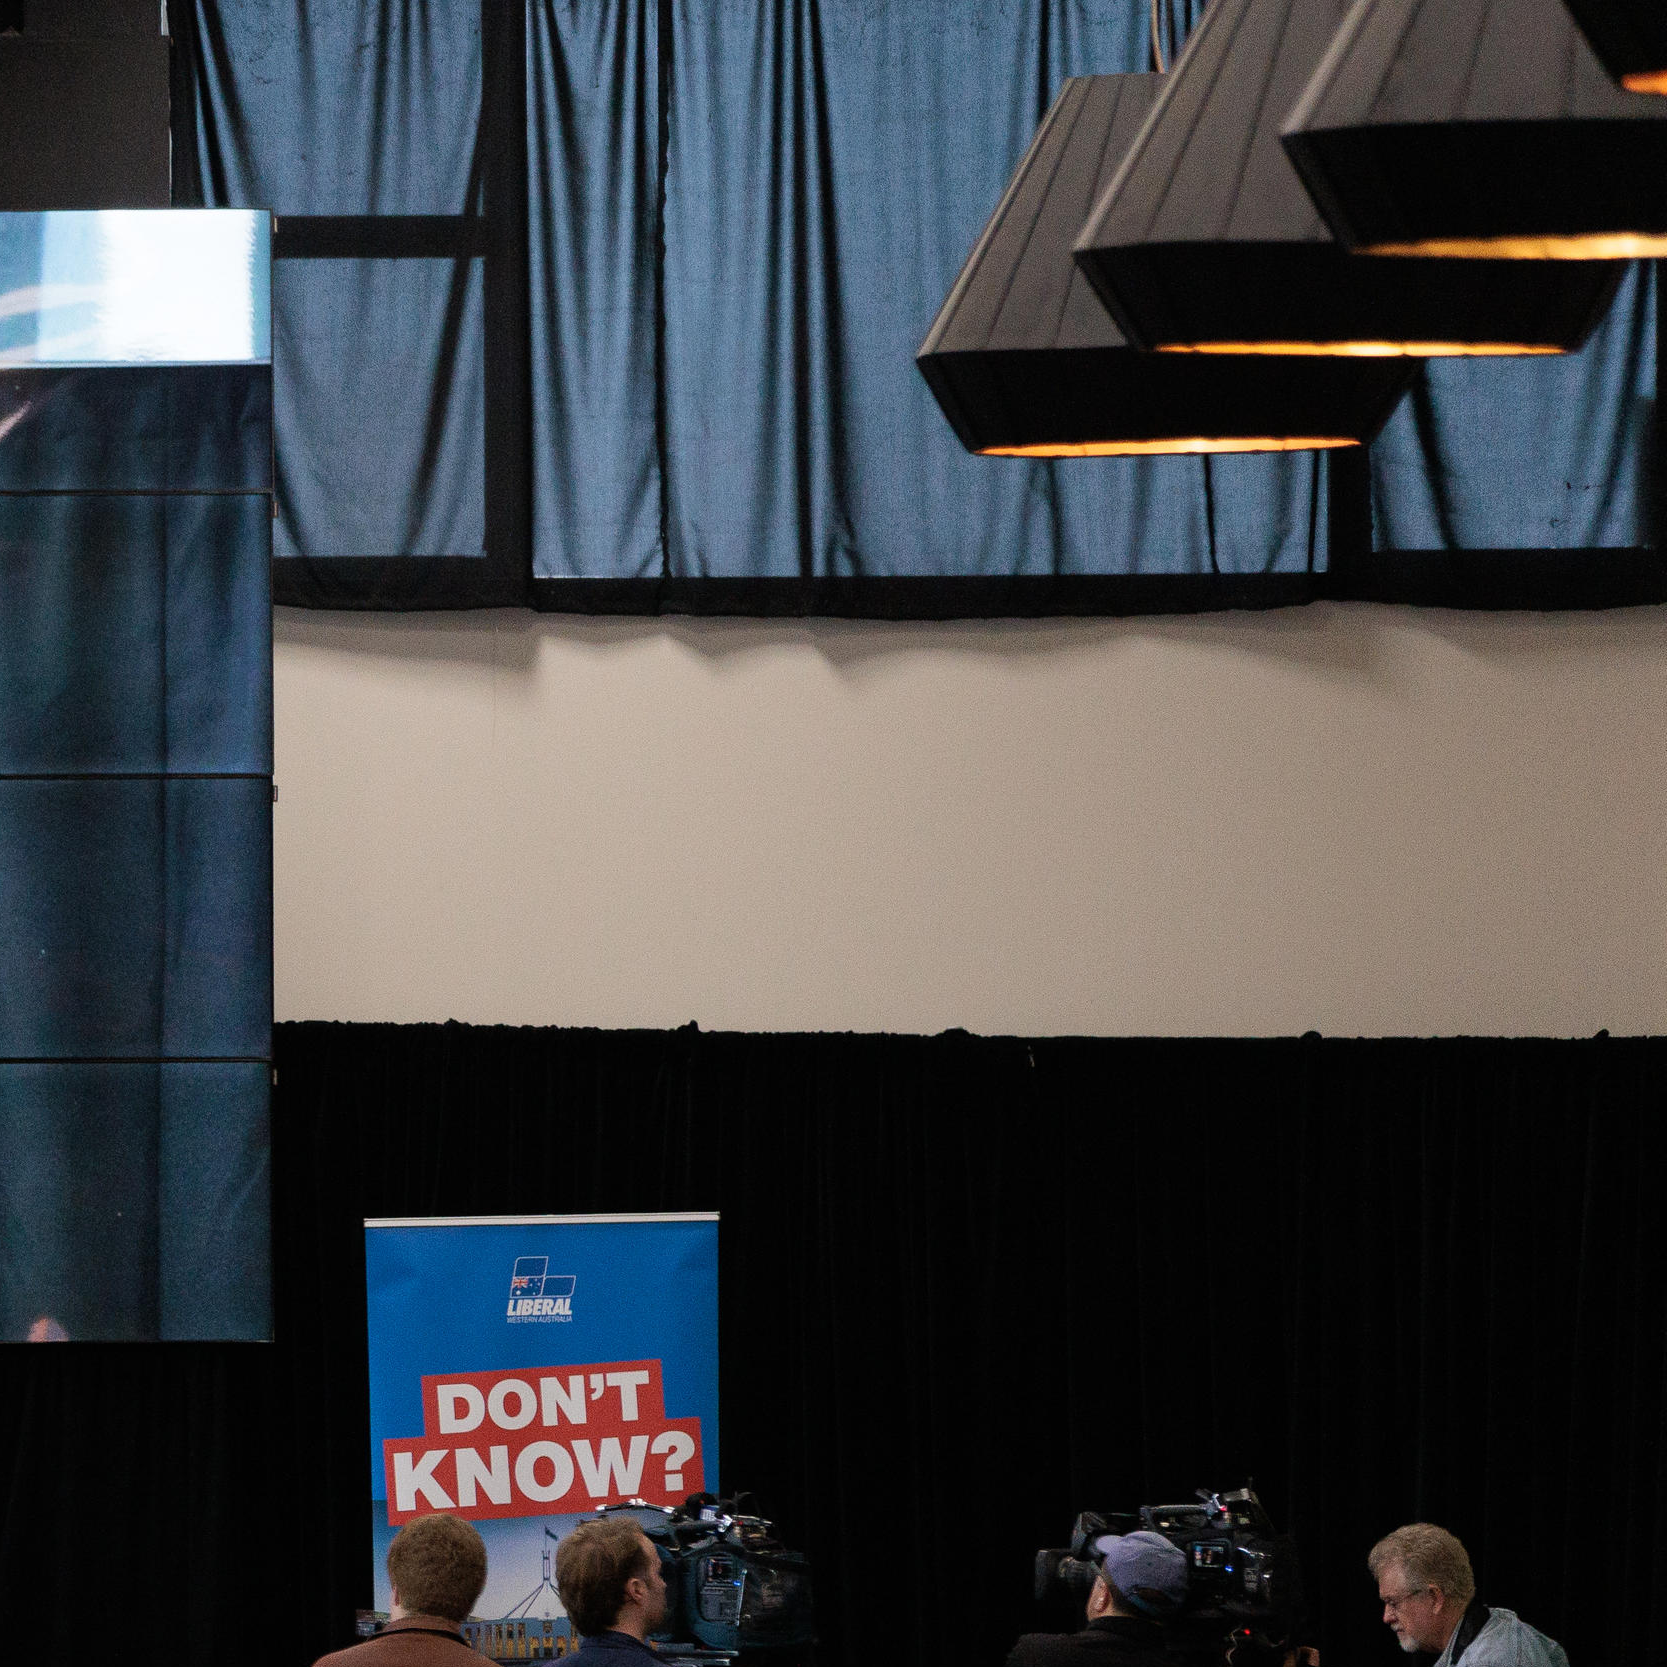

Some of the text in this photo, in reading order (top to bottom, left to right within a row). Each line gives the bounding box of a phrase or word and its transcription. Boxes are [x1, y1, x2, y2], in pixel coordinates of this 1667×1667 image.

[507, 1298, 573, 1316] LIBERAL
[538, 1315, 573, 1323] AUSTRALIA
[436, 1370, 650, 1435] DON'T
[393, 1430, 696, 1512] KNOW?
